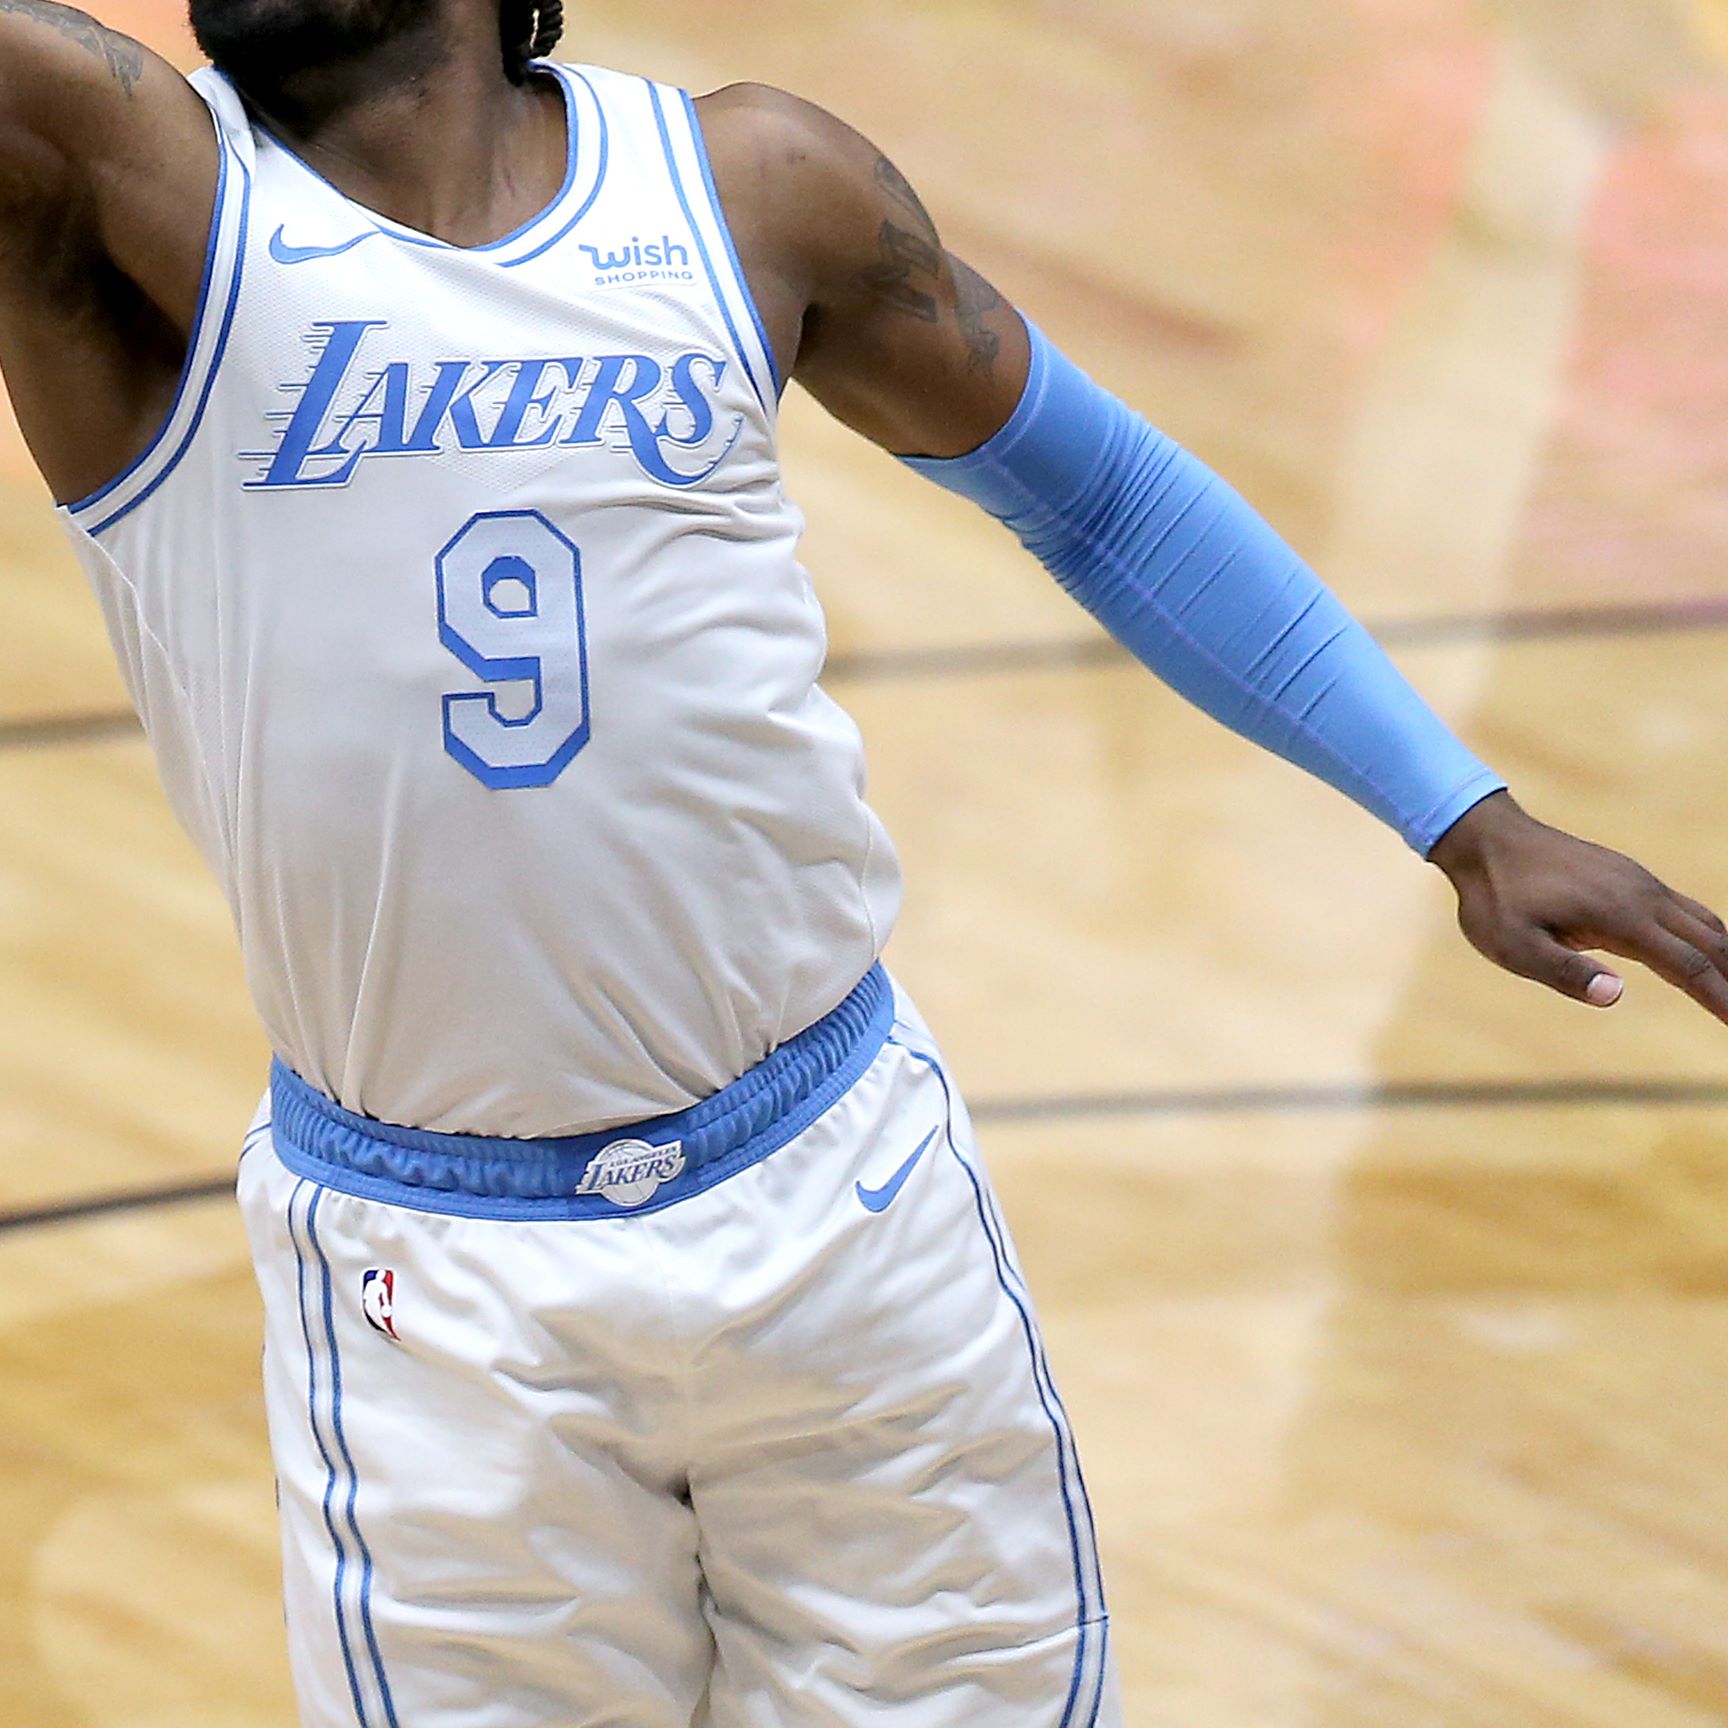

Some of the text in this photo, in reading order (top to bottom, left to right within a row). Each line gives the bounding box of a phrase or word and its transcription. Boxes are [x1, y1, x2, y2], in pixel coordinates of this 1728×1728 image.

[578, 235, 688, 270] wish
[594, 270, 693, 285] SHOPPING
[240, 319, 744, 492] LAKERS
[434, 508, 591, 790] 9
[578, 1153, 684, 1192] LAKERS
